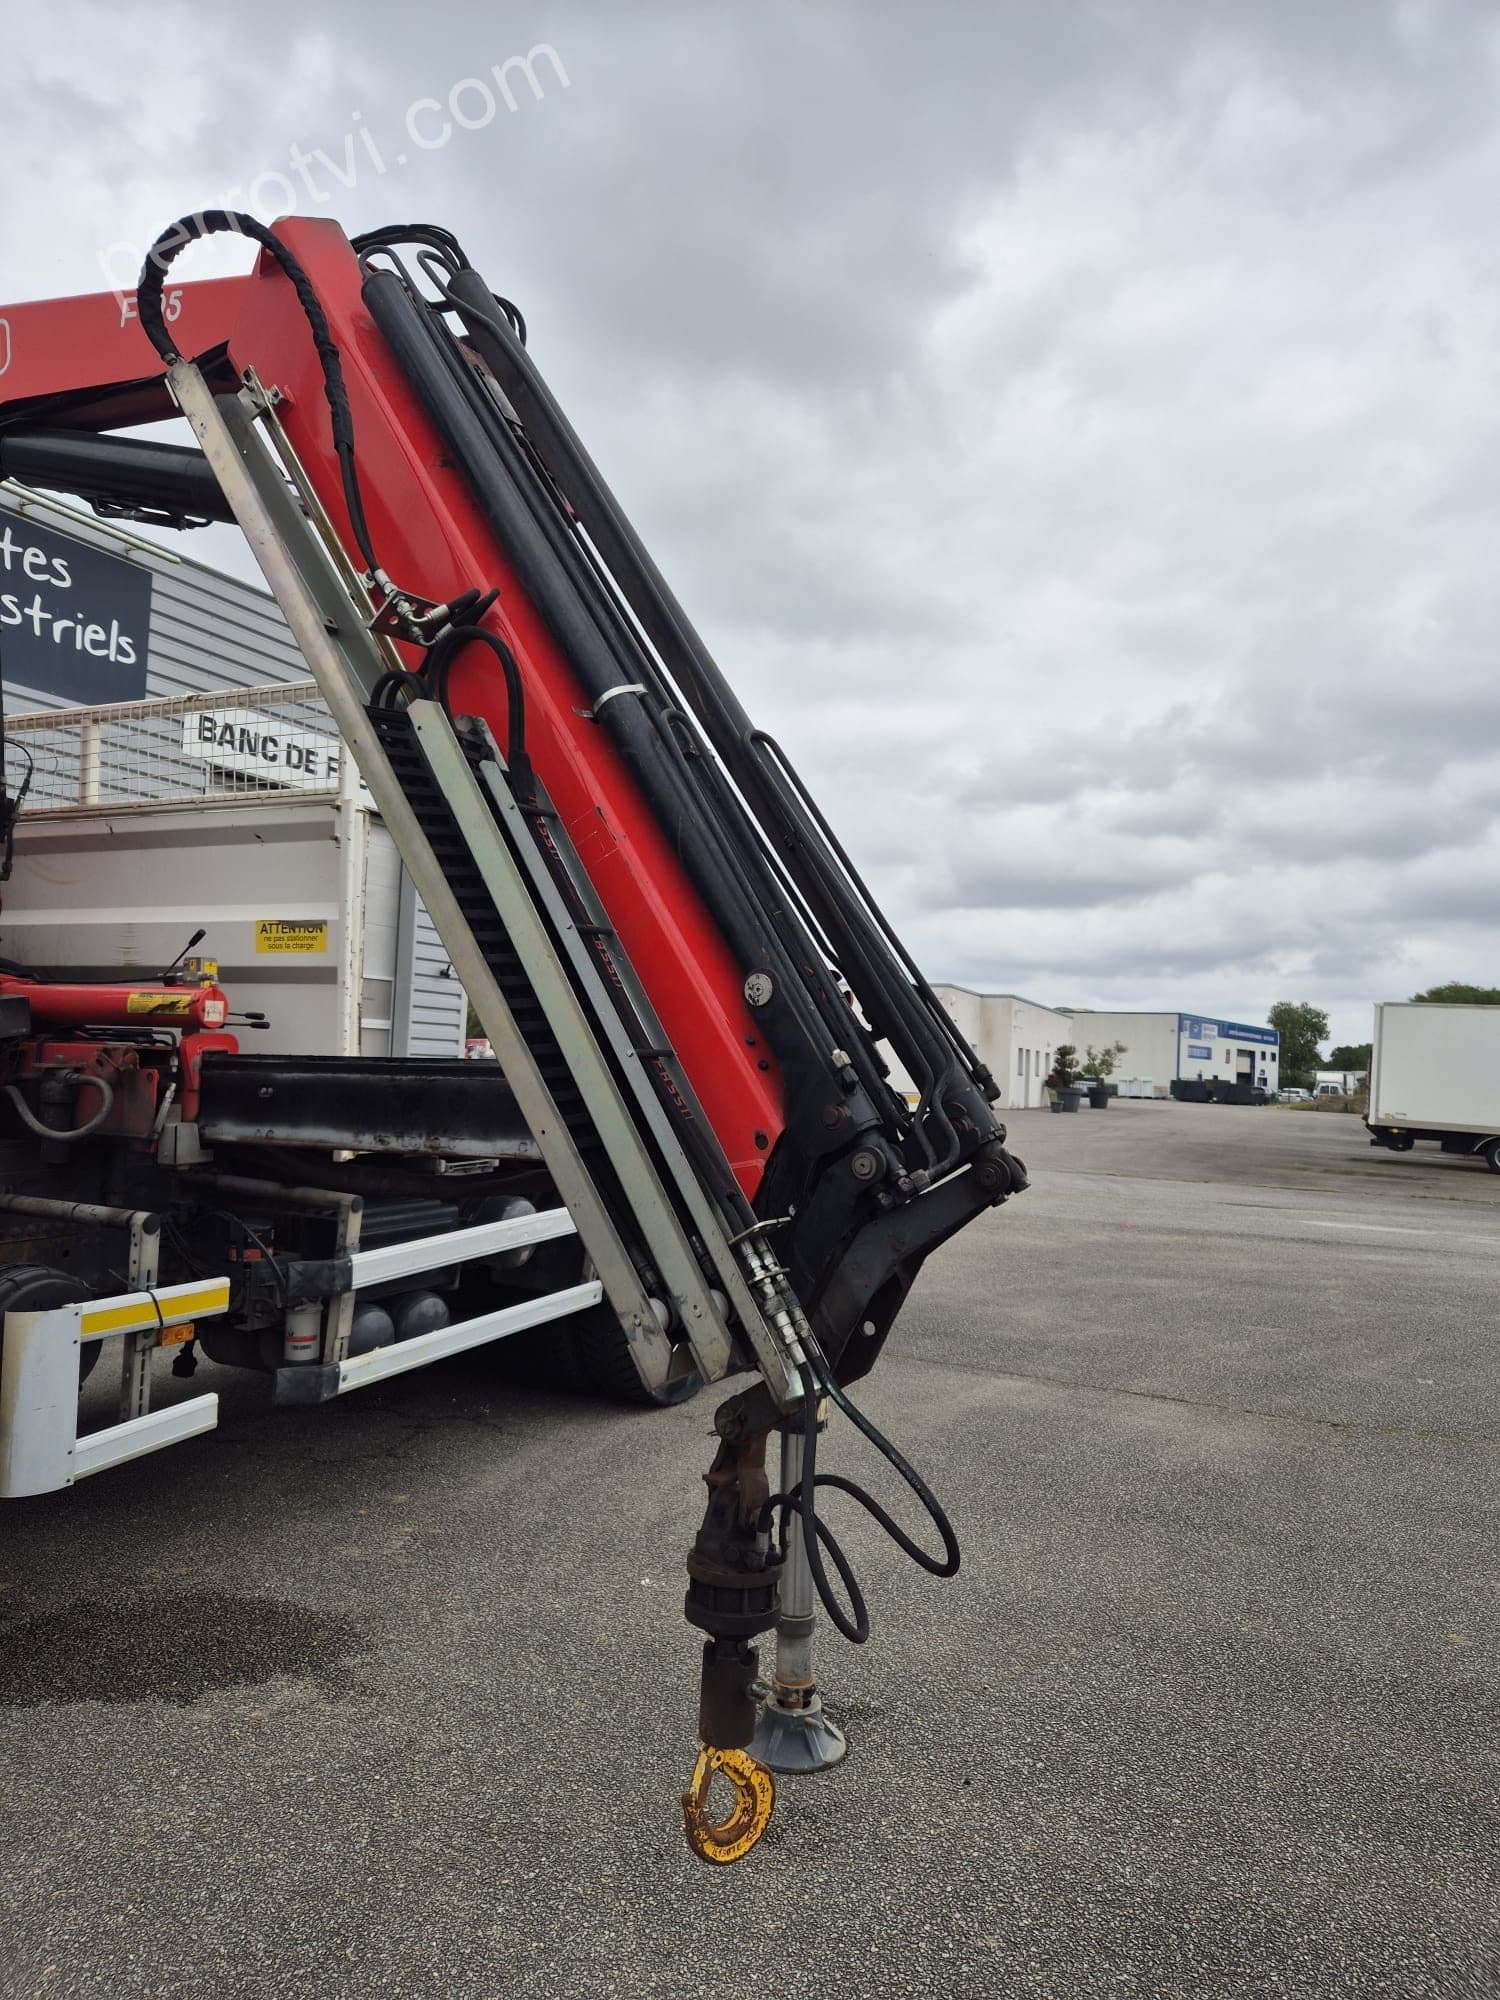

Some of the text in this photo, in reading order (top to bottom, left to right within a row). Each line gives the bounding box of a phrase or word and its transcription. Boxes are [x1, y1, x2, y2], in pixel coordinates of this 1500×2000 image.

[0, 527, 72, 588] tes
[0, 594, 136, 664] striels
[198, 714, 279, 763] BANC
[286, 743, 318, 775] DE
[260, 922, 323, 934] ATTENTION
